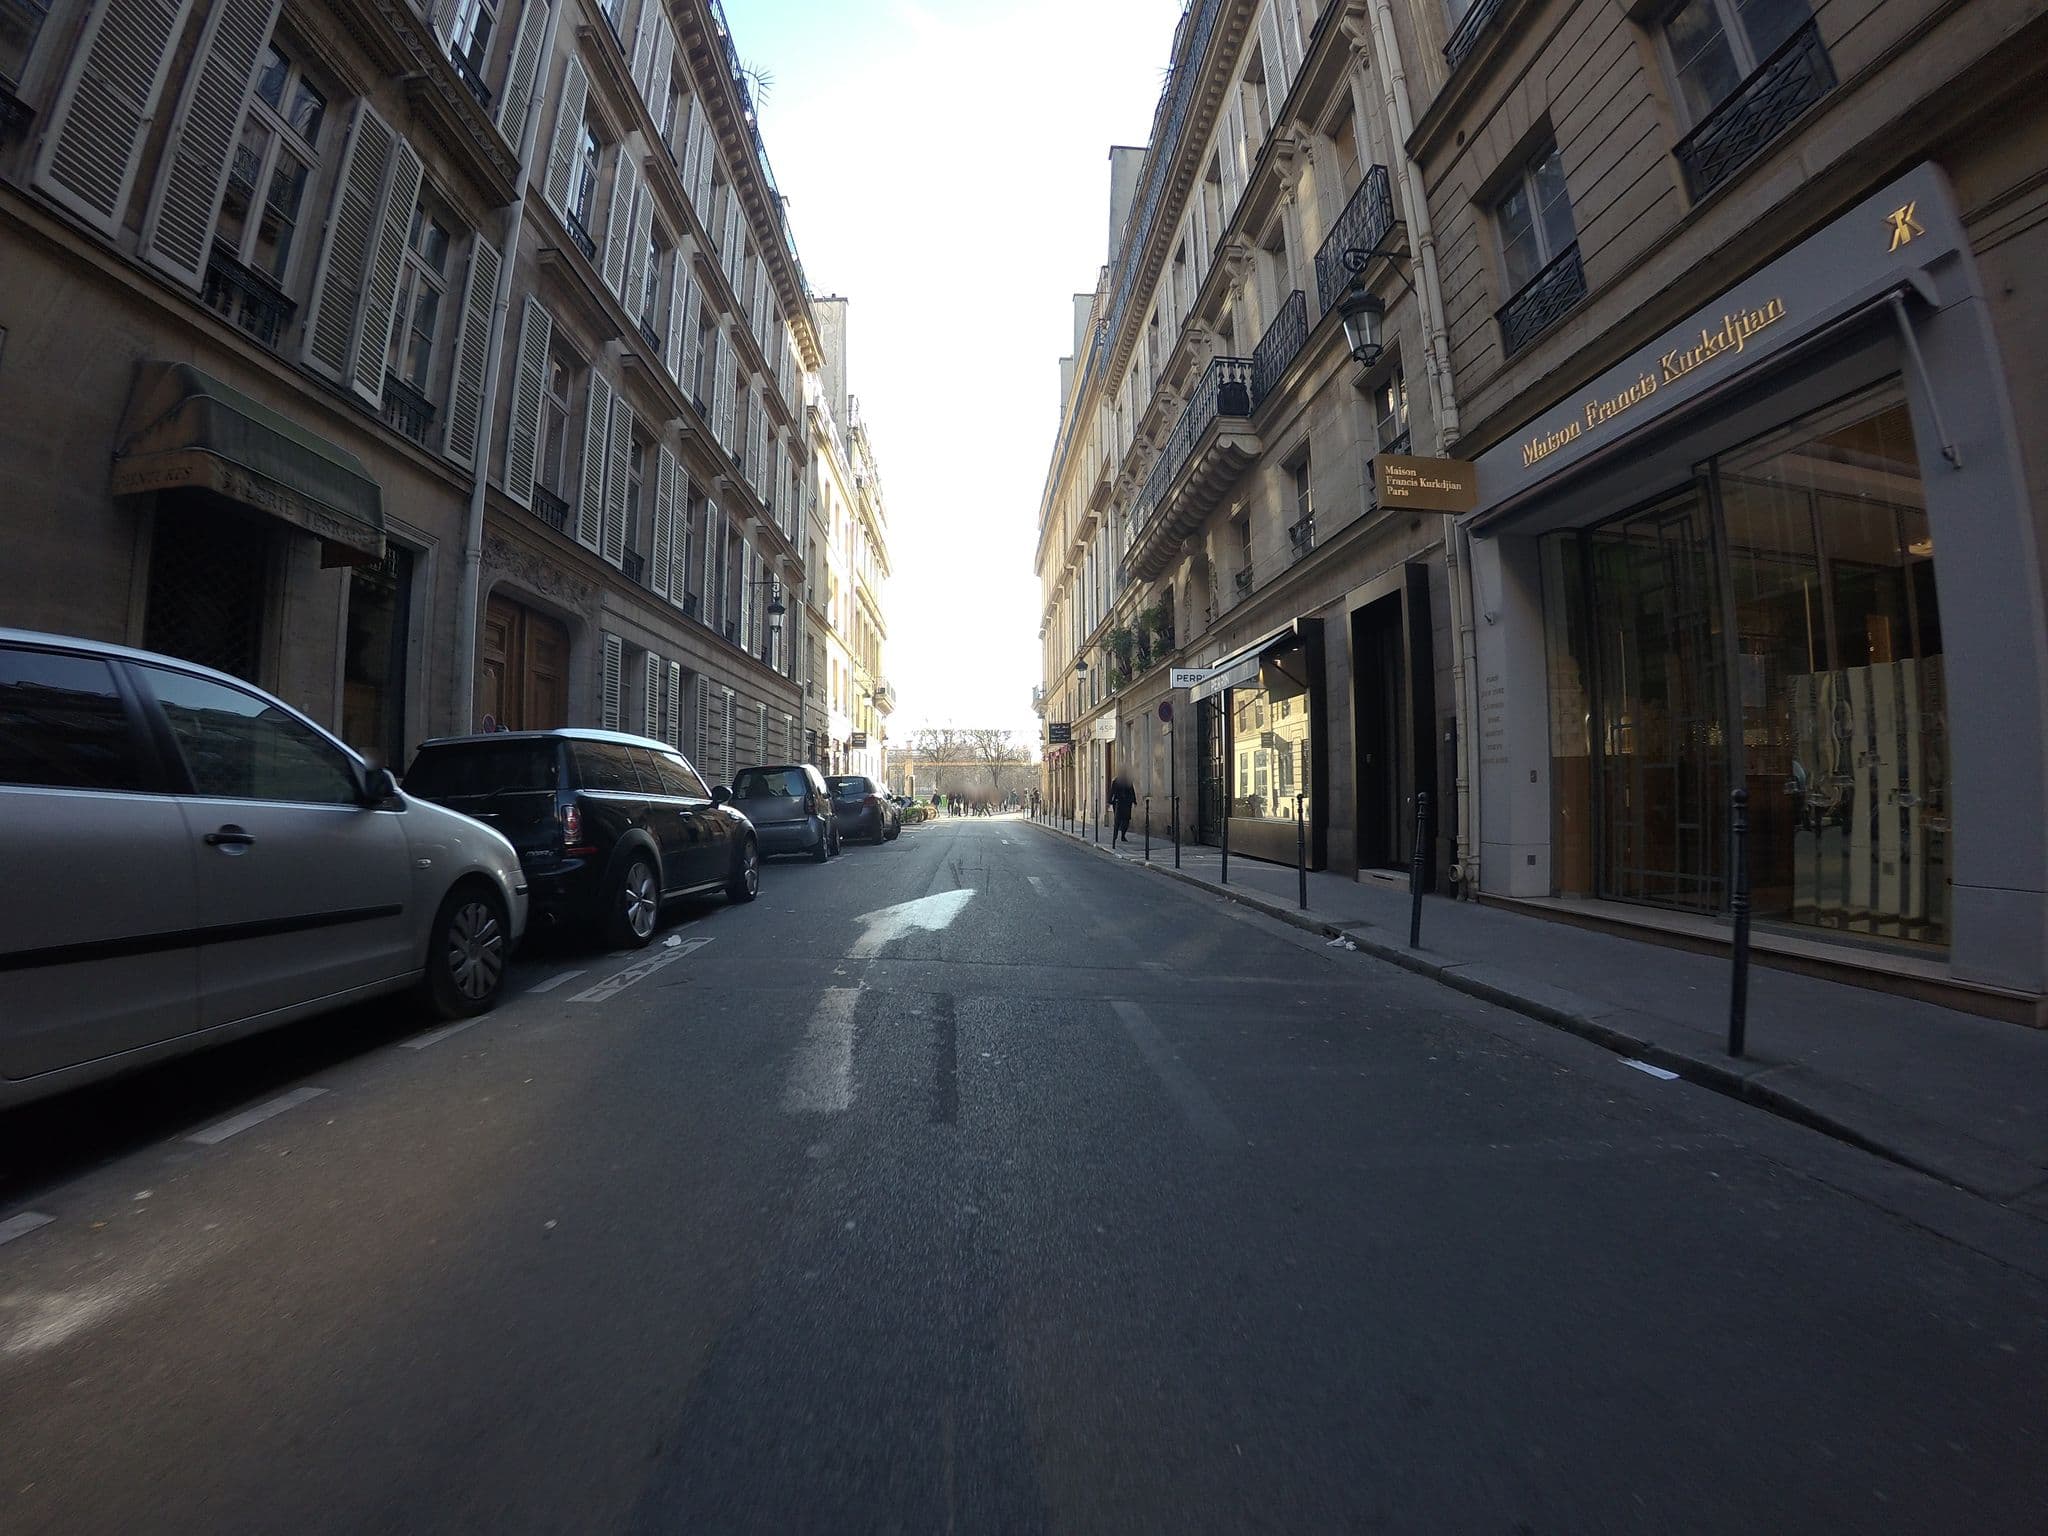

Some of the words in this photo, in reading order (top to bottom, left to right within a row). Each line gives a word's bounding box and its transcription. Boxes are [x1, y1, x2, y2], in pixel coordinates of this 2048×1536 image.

[1521, 420, 1582, 468] Maison
[1583, 372, 1657, 431] Francis
[1657, 297, 1786, 386] Kurkdjian
[1385, 465, 1417, 476] Maison
[1386, 475, 1418, 487] Francis
[1419, 477, 1462, 491] Kurkdjian
[1387, 486, 1409, 496] Paris
